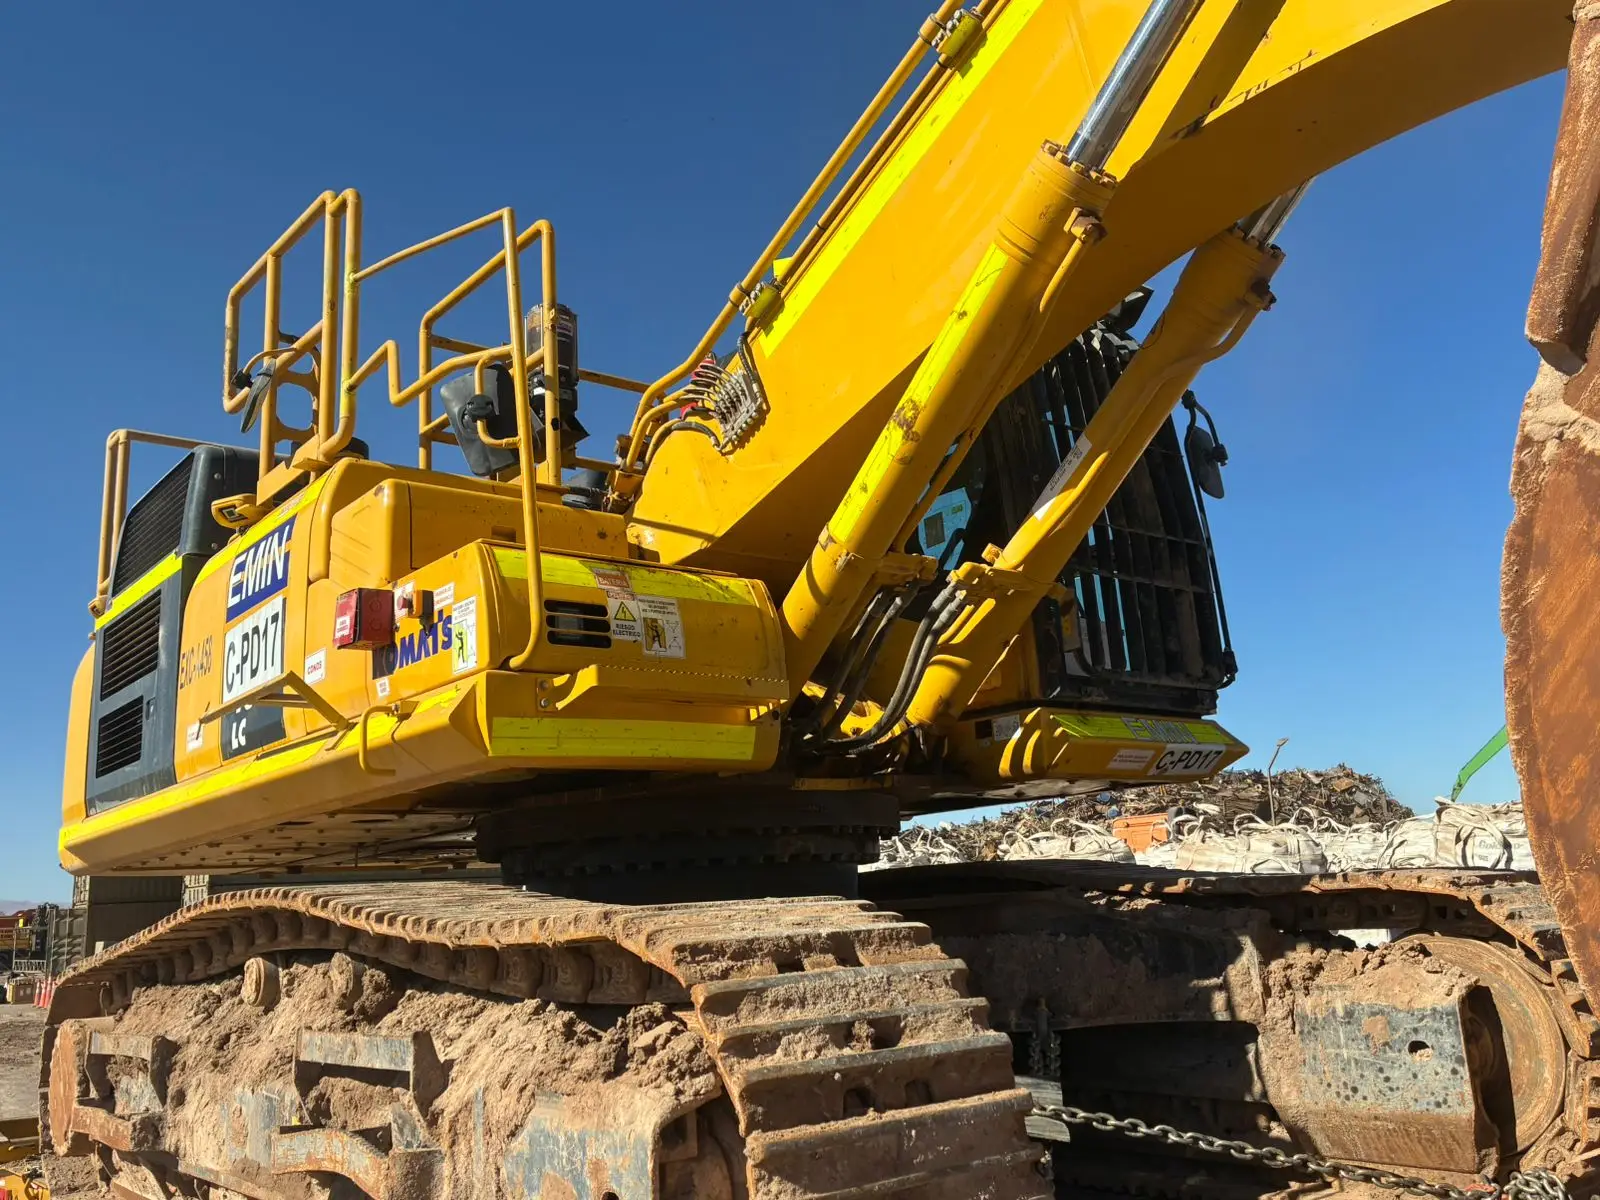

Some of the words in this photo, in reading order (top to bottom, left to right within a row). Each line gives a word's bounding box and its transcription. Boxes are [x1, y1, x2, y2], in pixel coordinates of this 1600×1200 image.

[227, 525, 290, 608] EMIN
[616, 623, 636, 631] RIESGO
[226, 611, 280, 693] C-PD17
[231, 717, 247, 750] LC
[1155, 750, 1224, 770] C-PD17
